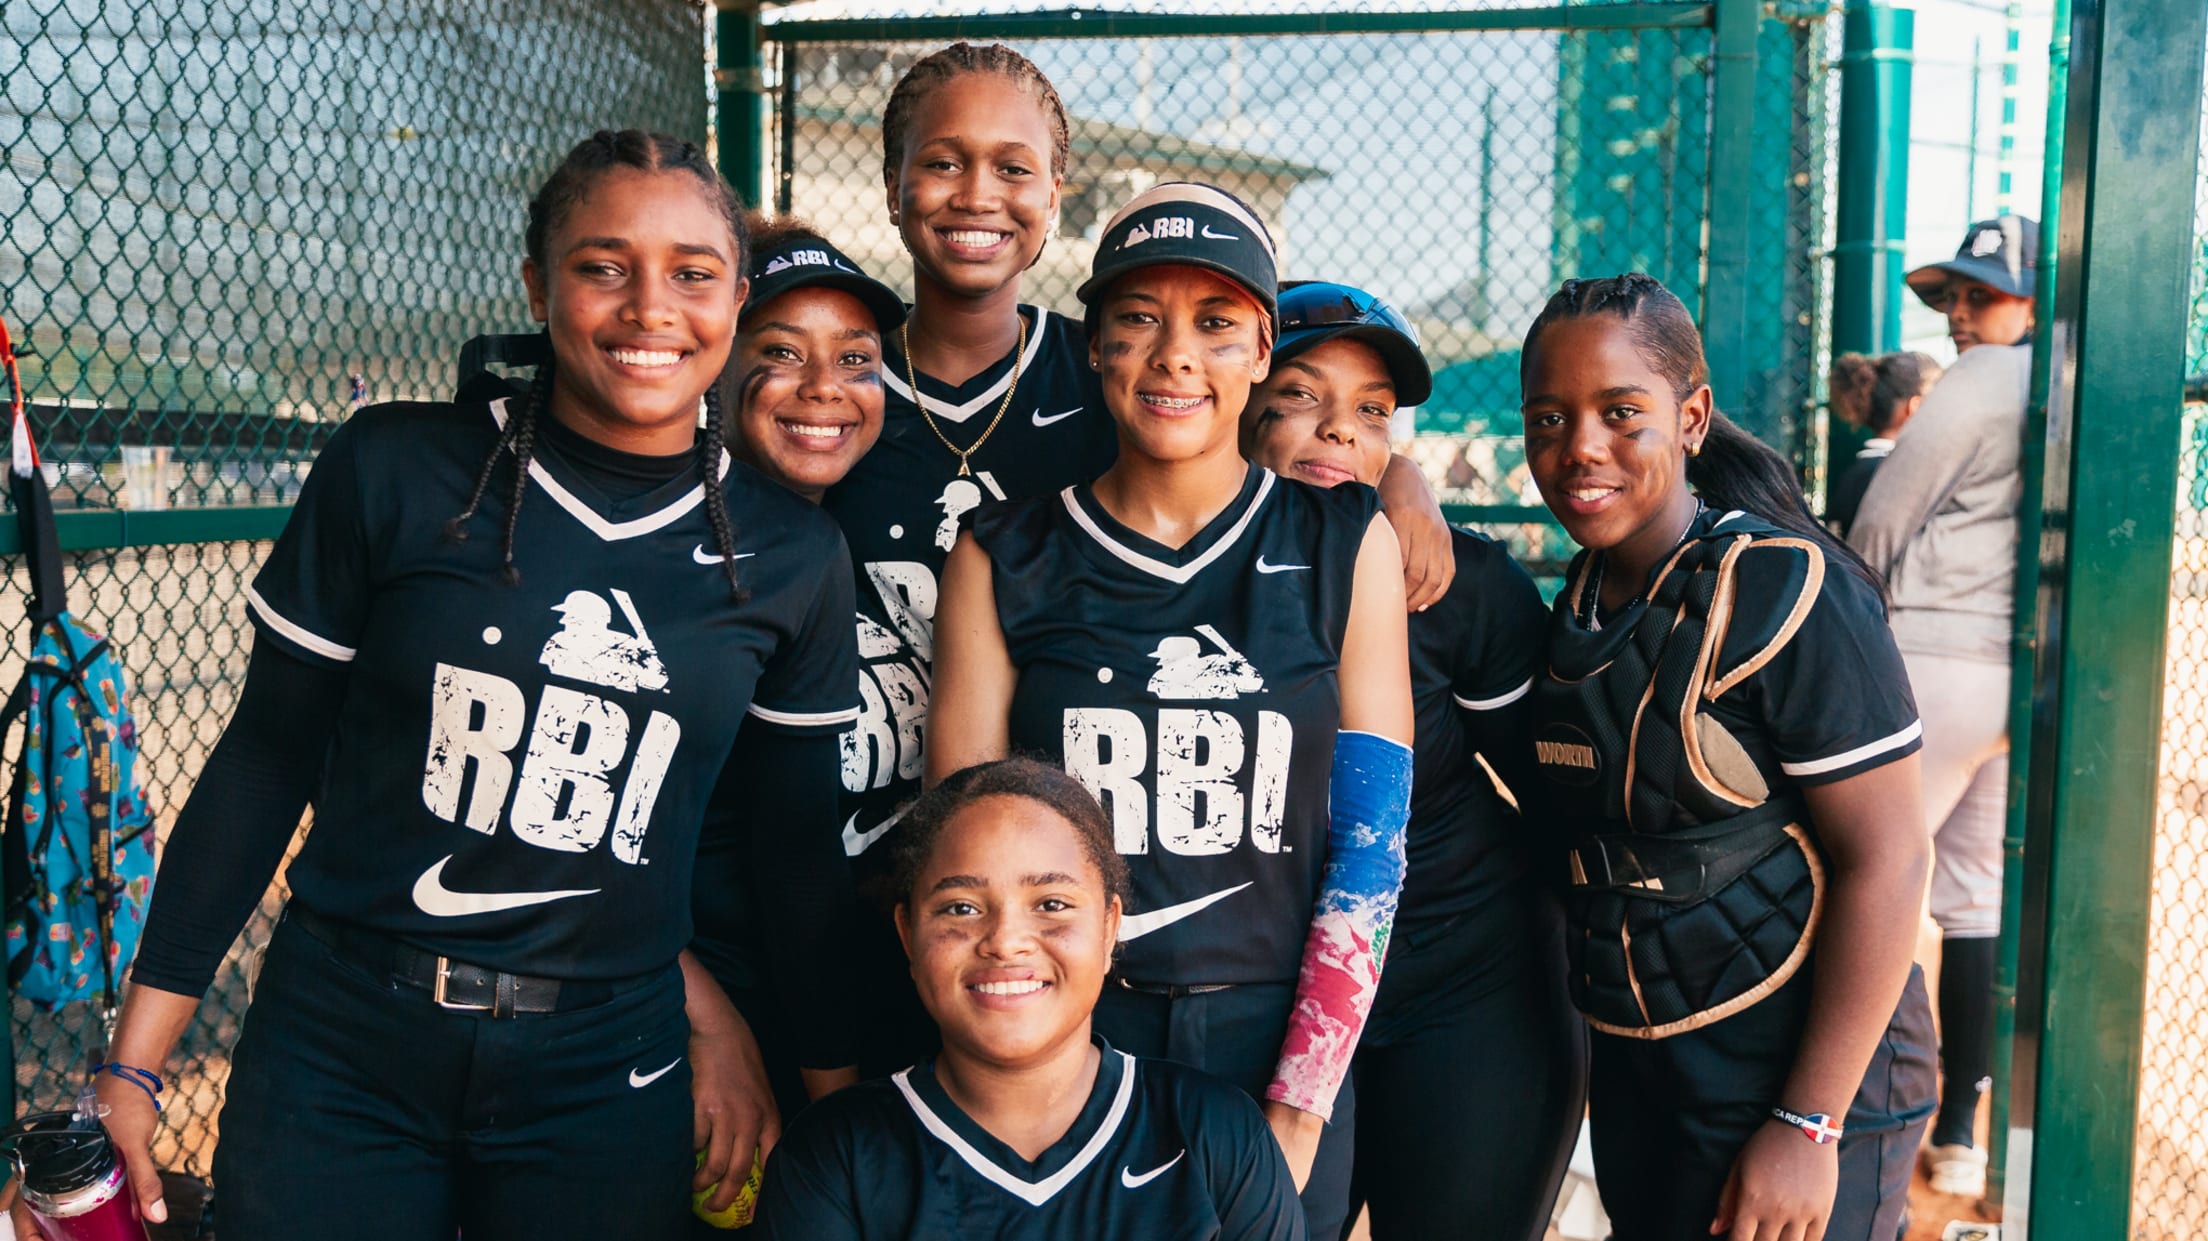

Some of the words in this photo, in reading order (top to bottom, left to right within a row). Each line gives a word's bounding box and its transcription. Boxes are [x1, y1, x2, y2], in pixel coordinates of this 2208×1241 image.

[1152, 217, 1194, 239] RBI
[792, 250, 830, 266] RBI
[422, 662, 681, 865] RBI
[1536, 741, 1594, 768] WORTH
[1063, 708, 1293, 856] RBI
